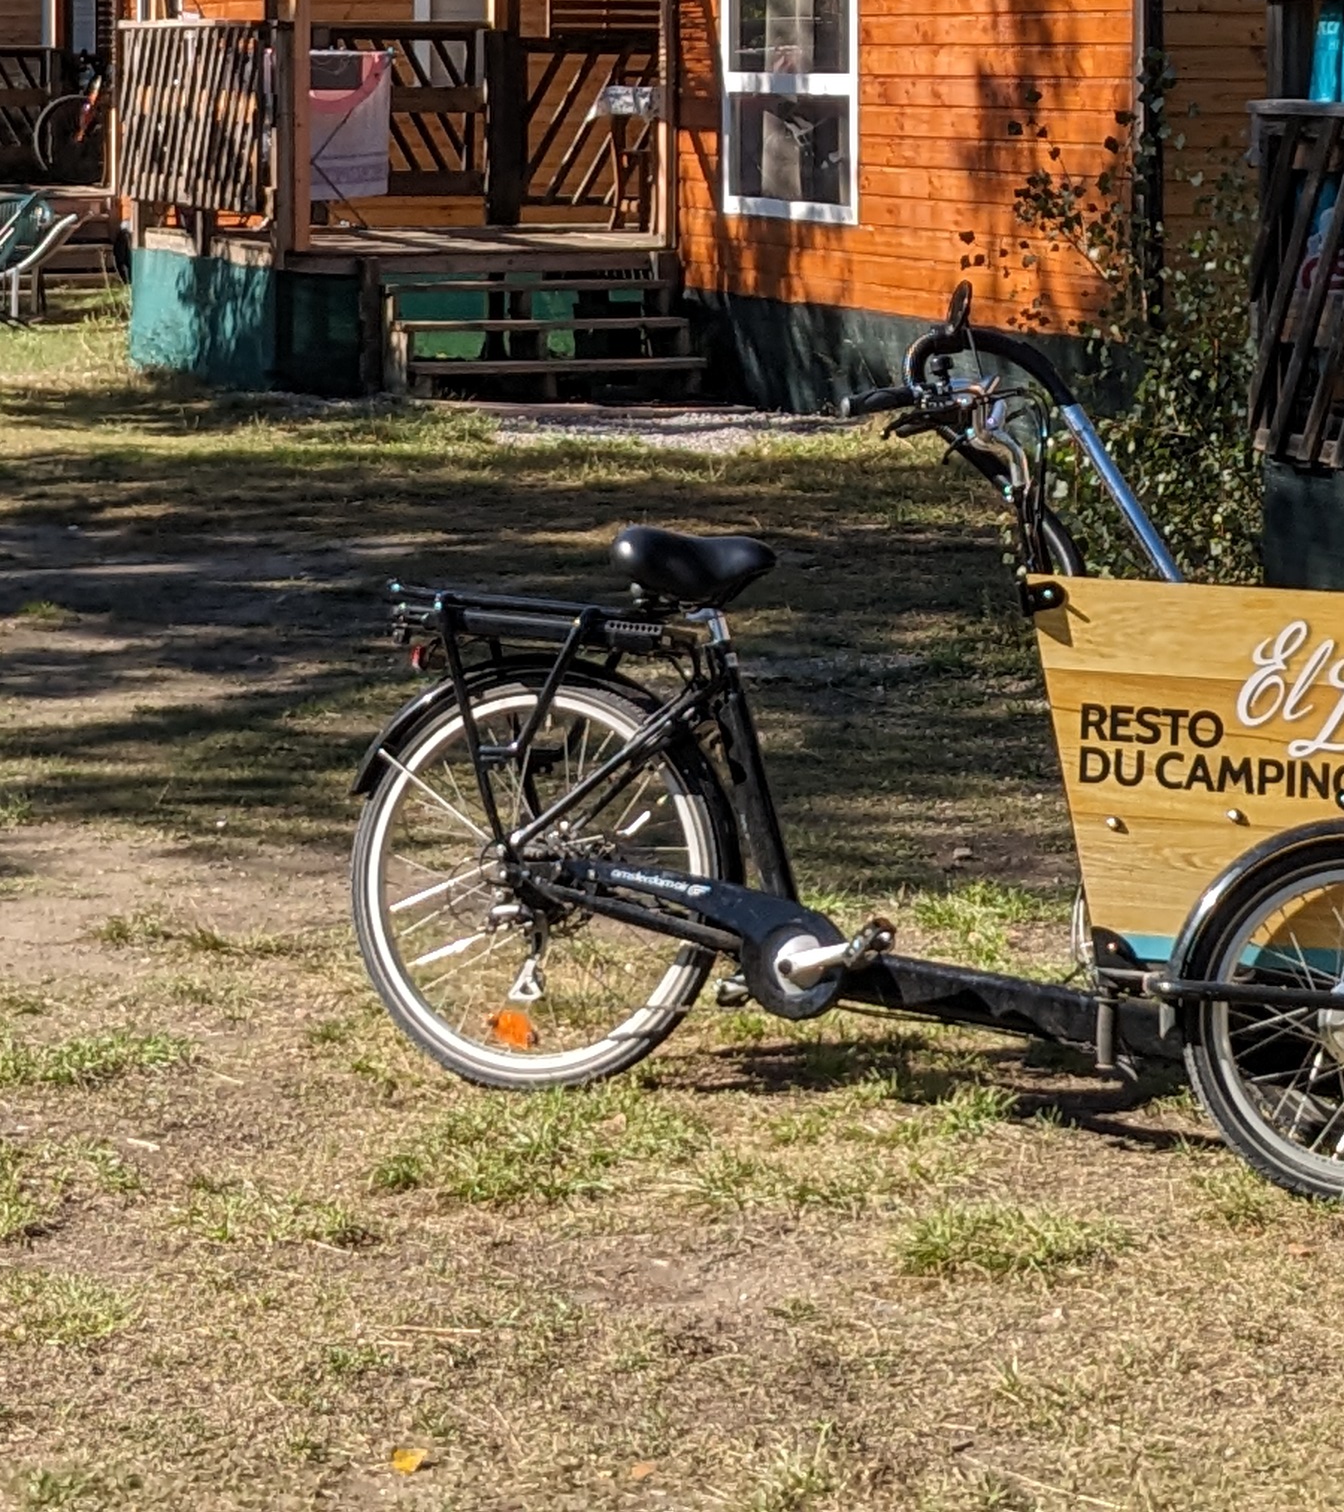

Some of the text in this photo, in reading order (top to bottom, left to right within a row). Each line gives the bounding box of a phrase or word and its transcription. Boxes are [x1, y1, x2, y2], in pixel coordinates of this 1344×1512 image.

[1237, 620, 1335, 727] El
[1080, 703, 1224, 749] RESTO
[1079, 748, 1146, 786] DU
